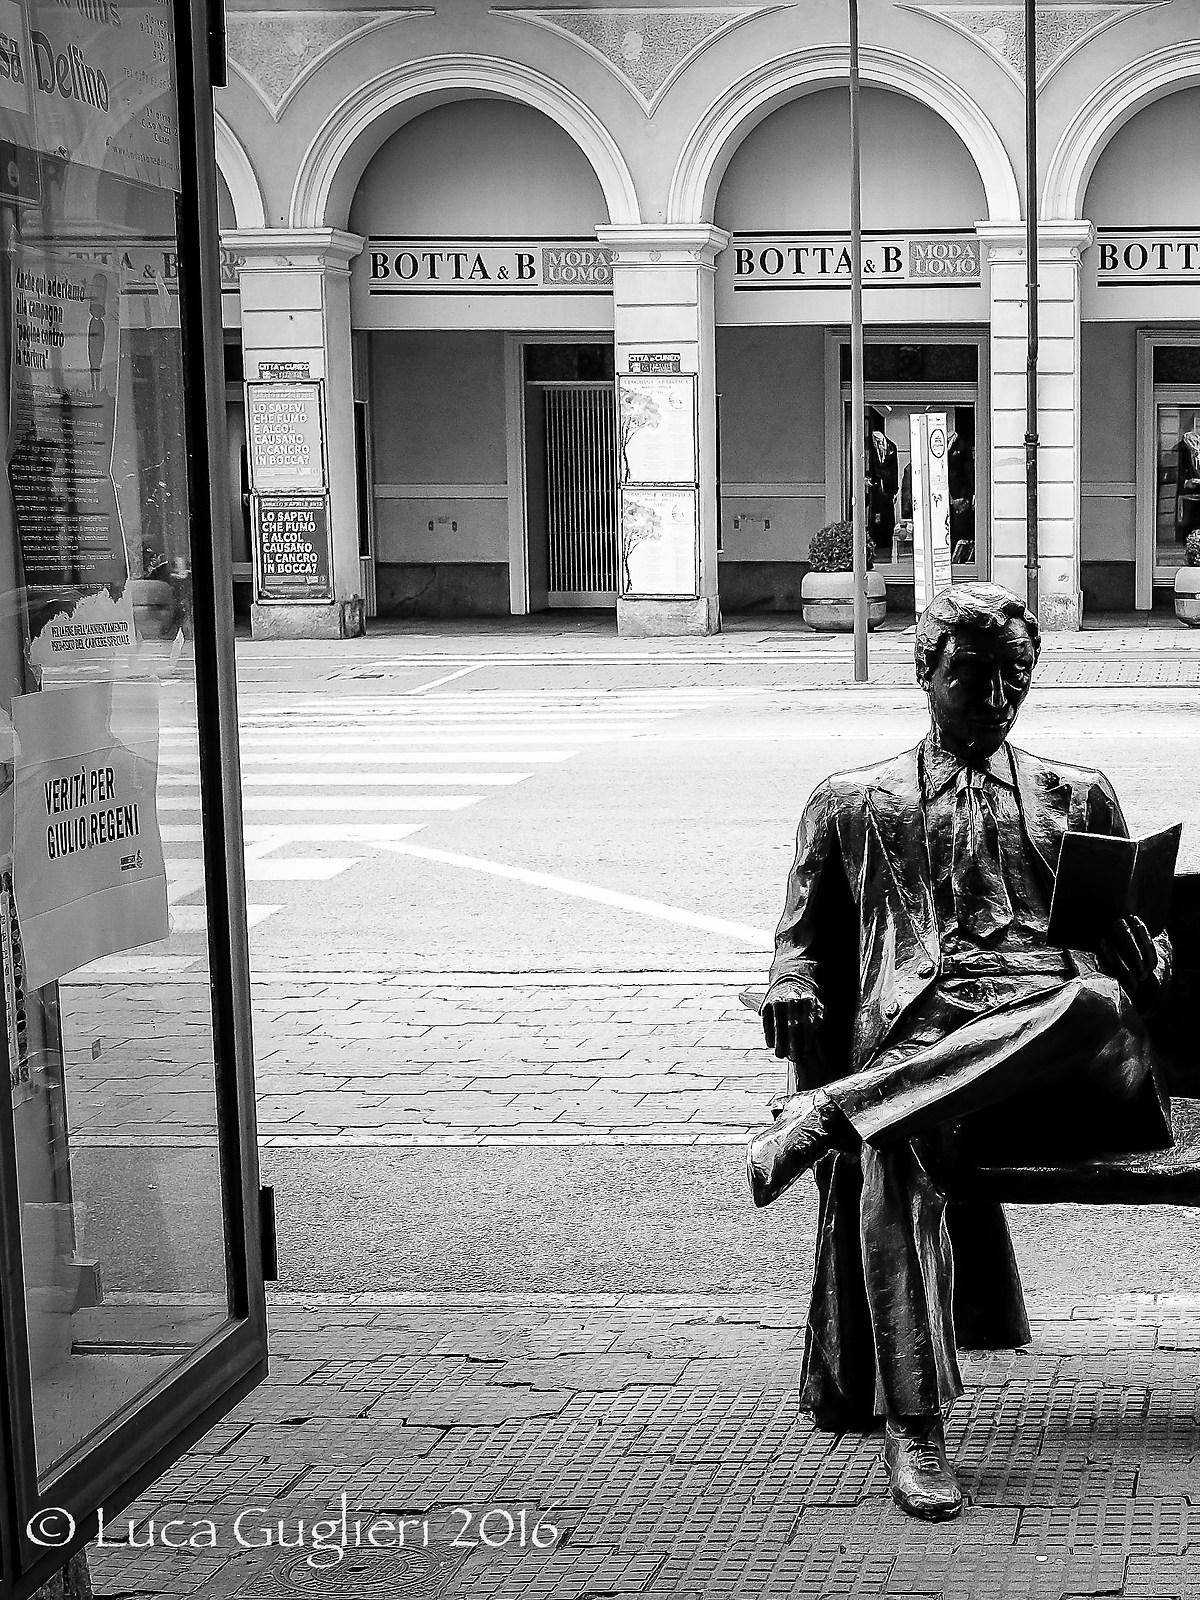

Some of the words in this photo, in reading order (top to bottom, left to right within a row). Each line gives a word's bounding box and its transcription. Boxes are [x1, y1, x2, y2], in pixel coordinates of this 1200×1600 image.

[30, 29, 109, 113] Delfino
[914, 243, 975, 259] MODA
[549, 251, 608, 266] MODA
[734, 247, 851, 275] BOTTA
[863, 259, 876, 273] &
[882, 246, 903, 273] B
[370, 252, 491, 280] BOTTA
[497, 265, 509, 280] &
[515, 252, 536, 280] B
[915, 258, 976, 274] UOMO
[549, 265, 609, 281] UOMO
[252, 403, 266, 413] LO
[268, 403, 305, 413] SAPEVI
[253, 413, 275, 423] CHE
[277, 413, 308, 423] FUMO
[254, 424, 261, 434] E
[262, 424, 295, 434] ALCOL
[254, 434, 304, 444] CAUSANO
[255, 445, 265, 455] IL
[266, 445, 310, 455] CANCRO
[255, 455, 267, 465] IN
[269, 455, 310, 465] BOCCA?
[261, 511, 275, 521] LO
[277, 511, 314, 521] SAPEVI
[262, 522, 284, 532] CHE
[285, 522, 317, 532] FUMO
[262, 532, 269, 542] E
[271, 532, 304, 542] ALCOL
[263, 543, 313, 553] CAUSANO
[263, 553, 274, 563] IL
[275, 553, 318, 563] CANCRO
[263, 563, 275, 573] IN
[277, 563, 318, 573] BOCCA?
[44, 765, 88, 815] VERITÀ
[90, 766, 115, 804] PER
[47, 816, 87, 860] GIULIO
[90, 803, 140, 846] REGENI
